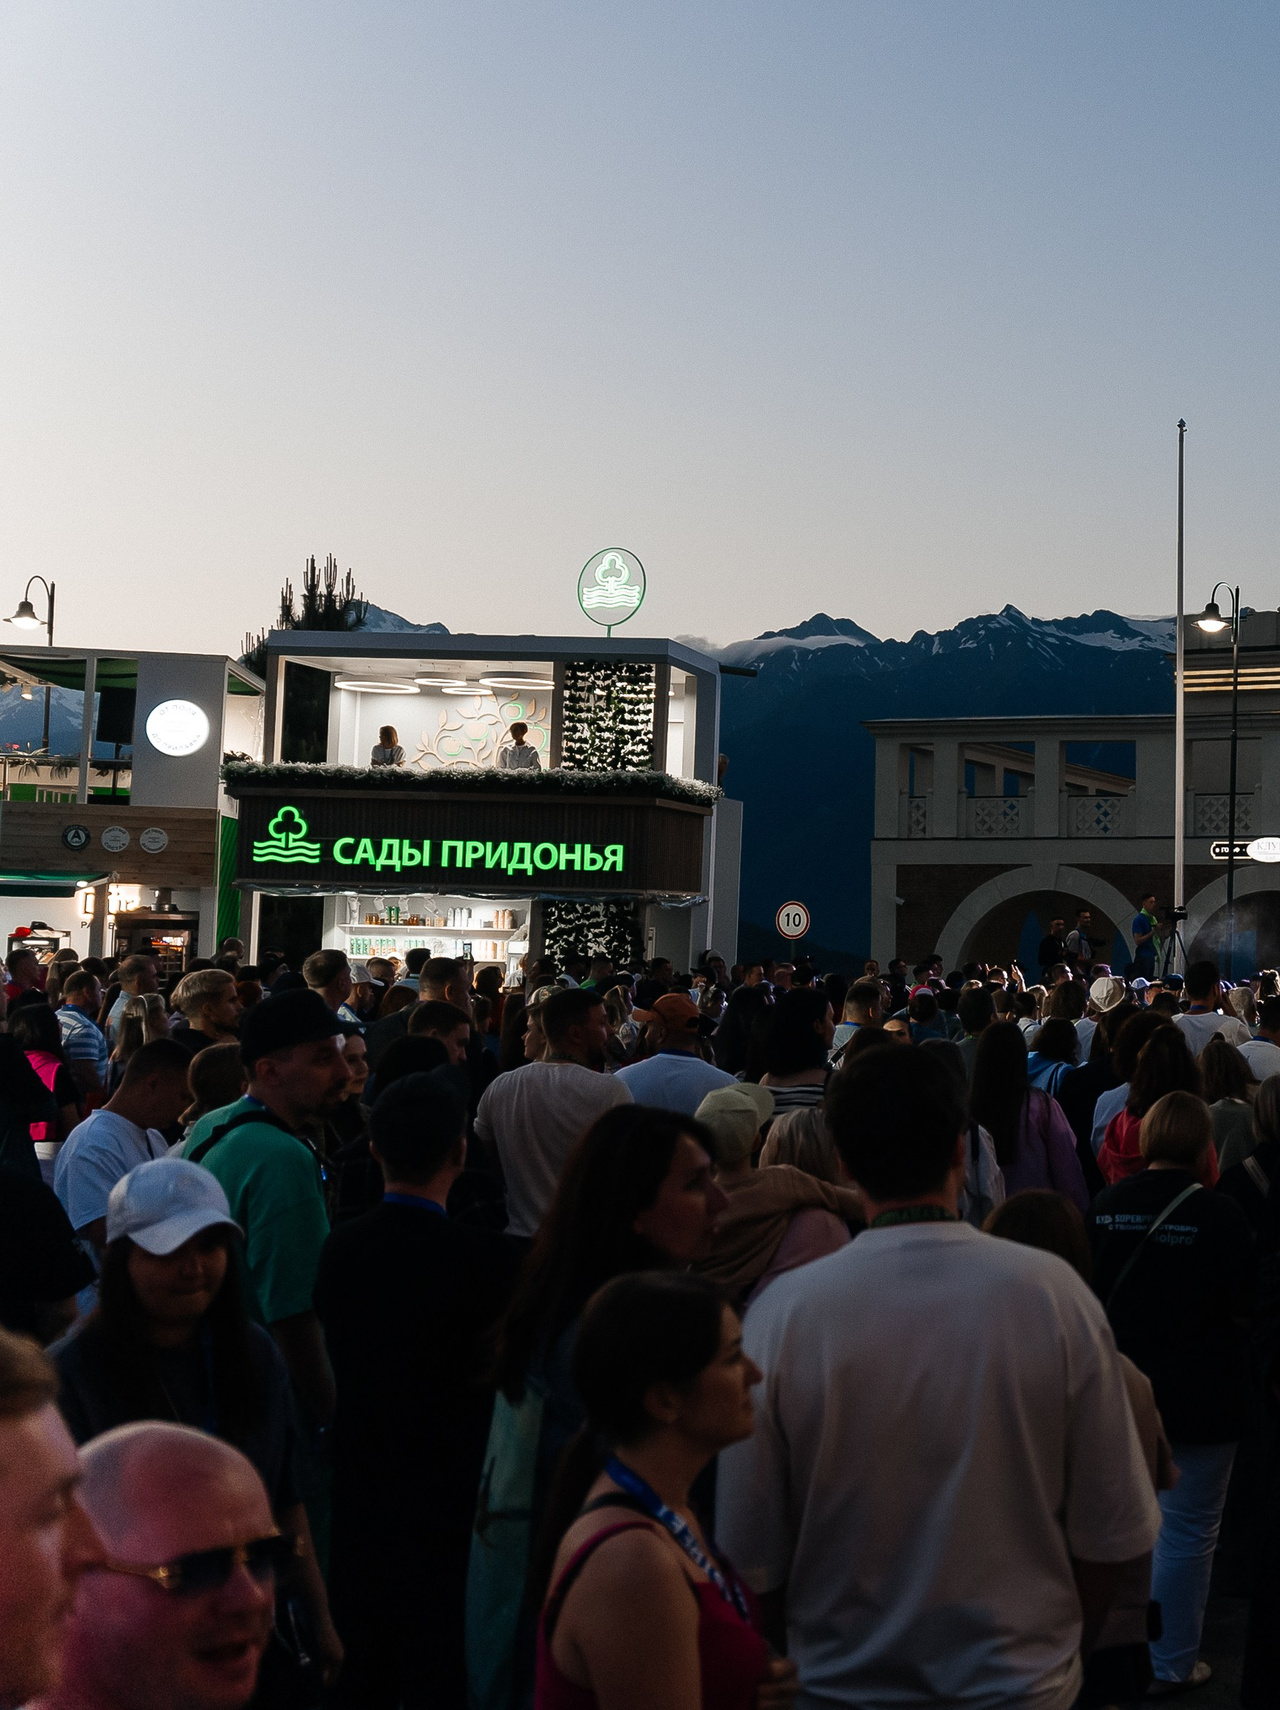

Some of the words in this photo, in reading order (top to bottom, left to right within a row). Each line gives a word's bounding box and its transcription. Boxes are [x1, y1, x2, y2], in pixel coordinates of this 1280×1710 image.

[333, 837, 431, 873] САДЫ
[440, 840, 625, 876] ПРИДОНЬЯ
[783, 911, 802, 929] 10
